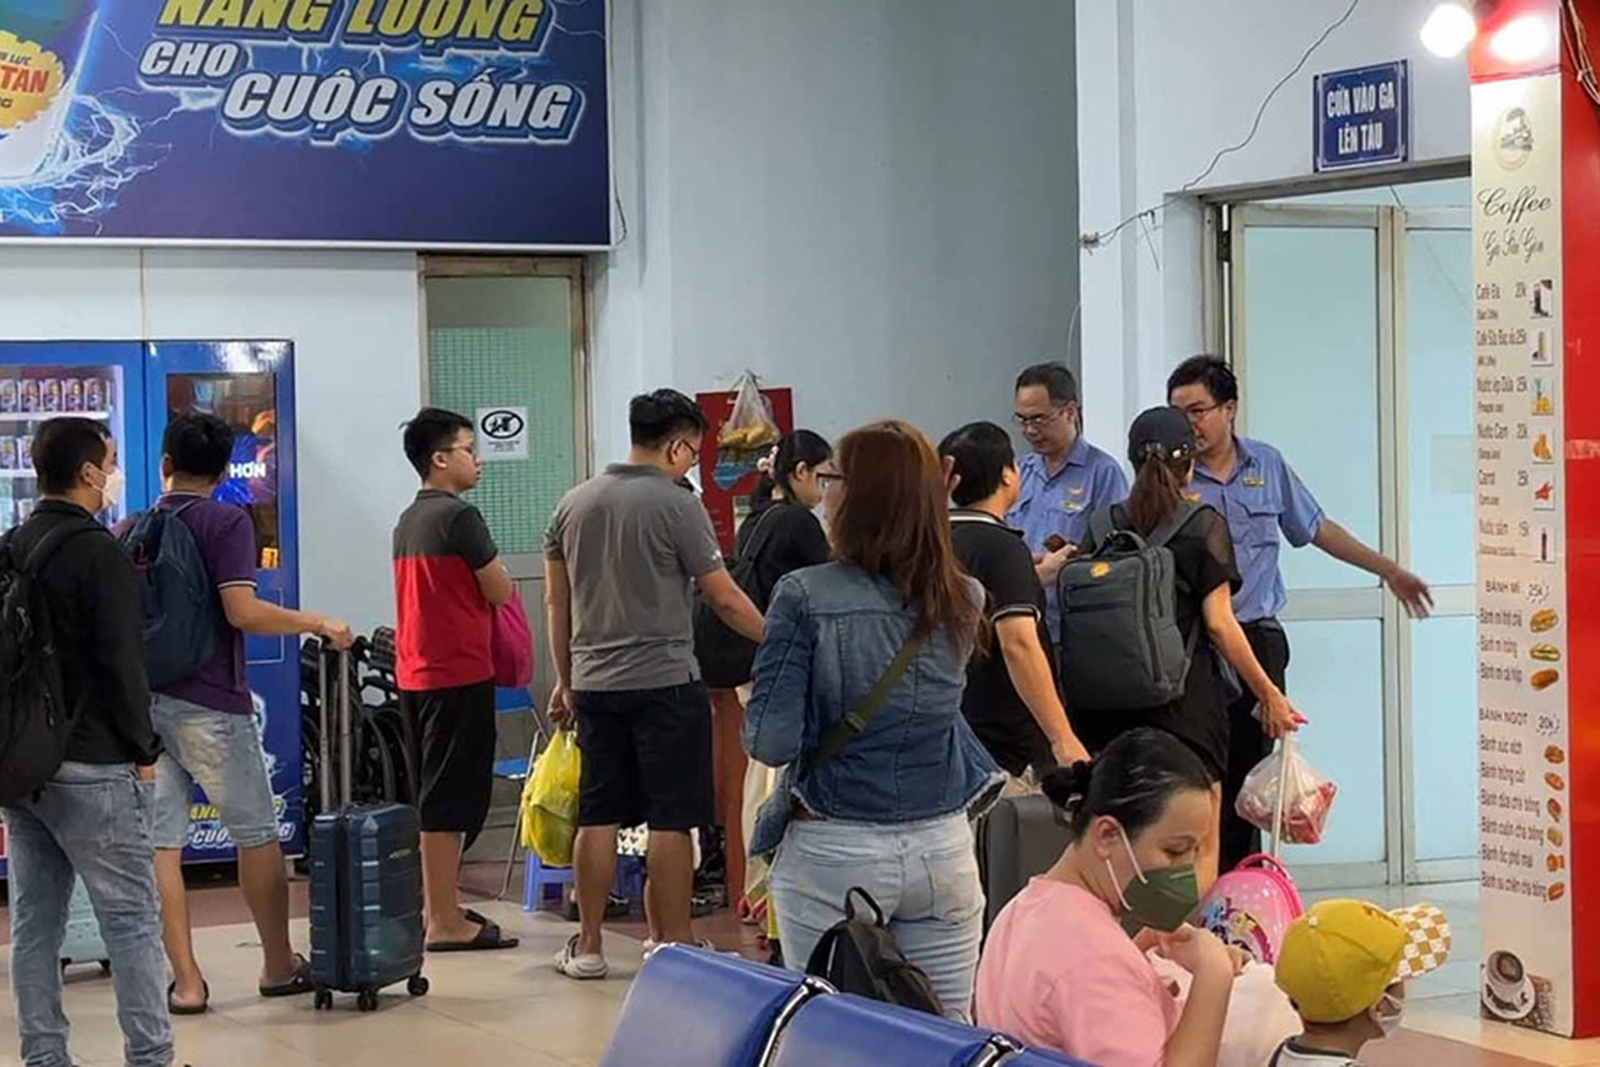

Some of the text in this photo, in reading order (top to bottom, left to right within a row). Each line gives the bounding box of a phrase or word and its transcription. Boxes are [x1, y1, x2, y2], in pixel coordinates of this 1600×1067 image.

[140, 40, 239, 77] CHO
[223, 67, 573, 130] CUỘC SỐNG
[1353, 82, 1376, 114] VÀO
[1379, 81, 1395, 110] GA
[1338, 119, 1384, 155] LÊN TÀU
[1477, 185, 1552, 224] Coffee
